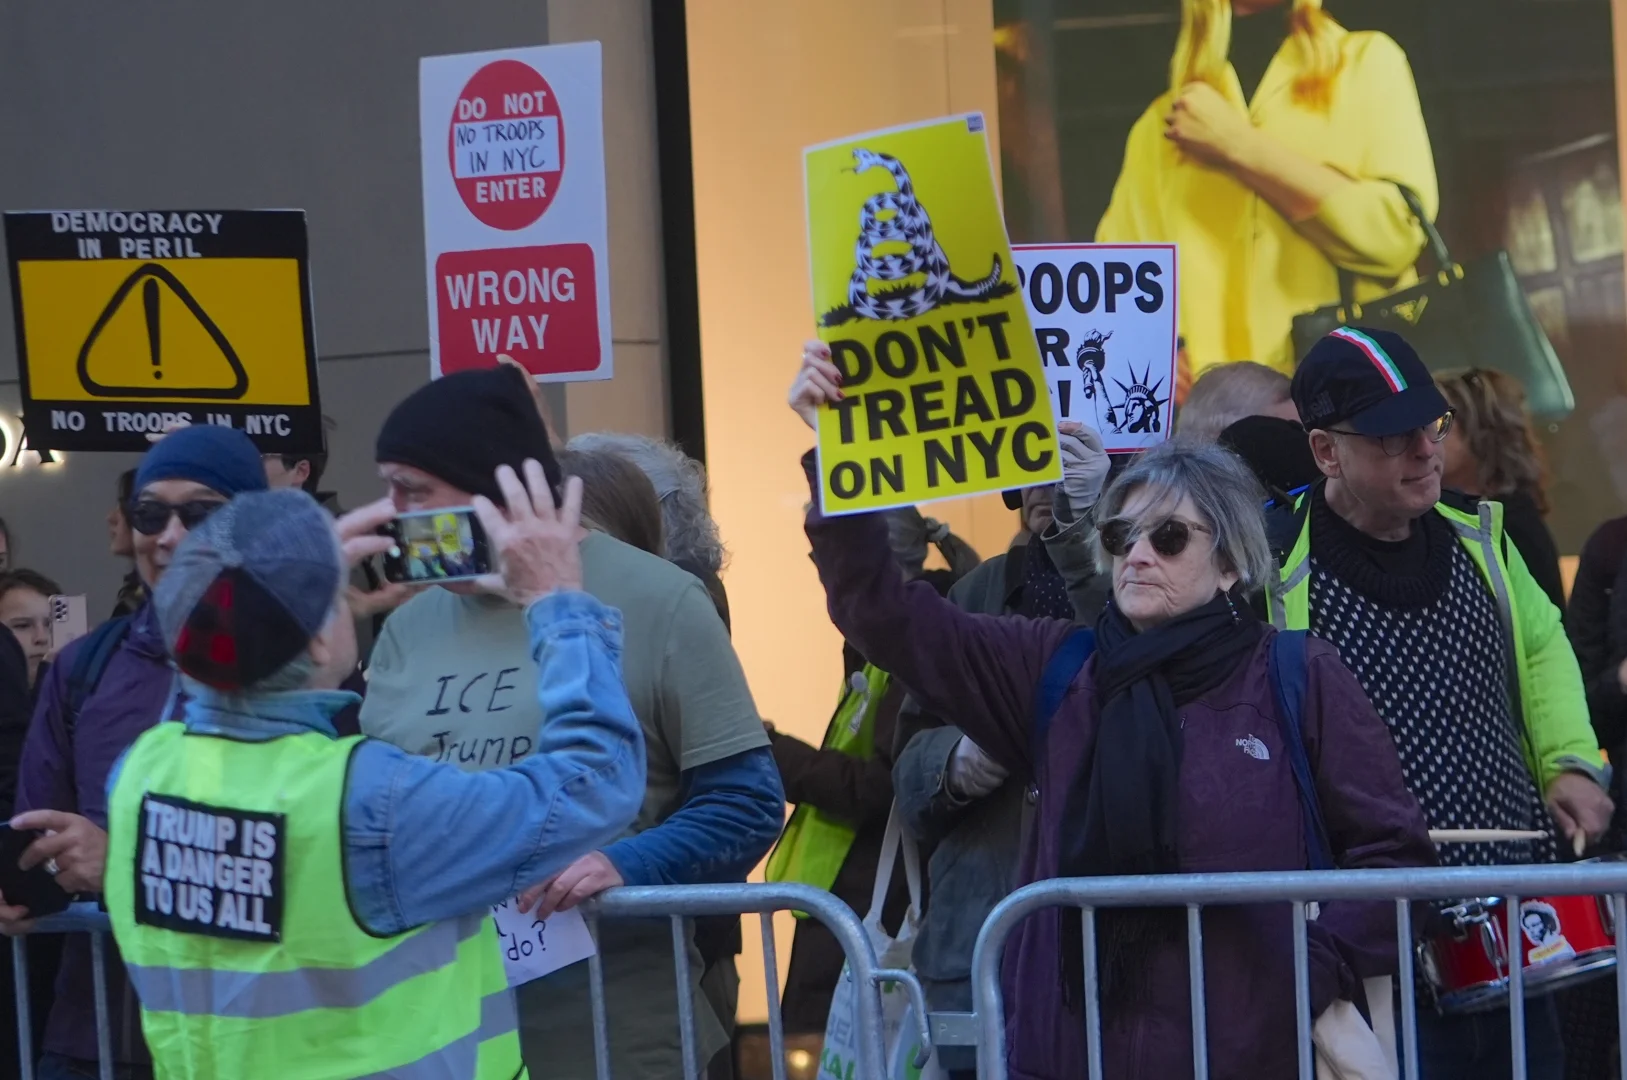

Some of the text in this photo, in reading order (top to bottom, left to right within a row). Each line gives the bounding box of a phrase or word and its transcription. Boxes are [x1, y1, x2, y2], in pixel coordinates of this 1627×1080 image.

[459, 90, 547, 120] DO NOT
[456, 120, 545, 147] NO TROOPS
[470, 145, 545, 174] IN NYC
[476, 176, 547, 203] ENTER
[51, 211, 223, 234] DEMOCRACY
[78, 237, 202, 259] IN PERIL
[445, 267, 575, 310] WRONG
[1016, 261, 1164, 314] OOPS
[471, 314, 549, 354] WAY
[828, 311, 1012, 389] DON'T
[51, 409, 86, 431] NO
[102, 412, 193, 433] TROOPS
[245, 414, 291, 436] NYC
[828, 368, 1037, 445] TREAD
[829, 421, 1054, 500] ON NYC
[426, 667, 521, 716] ICE
[144, 800, 276, 860] TRUMP IS
[142, 838, 273, 898] A DANGER
[141, 873, 272, 935] TO US ALL
